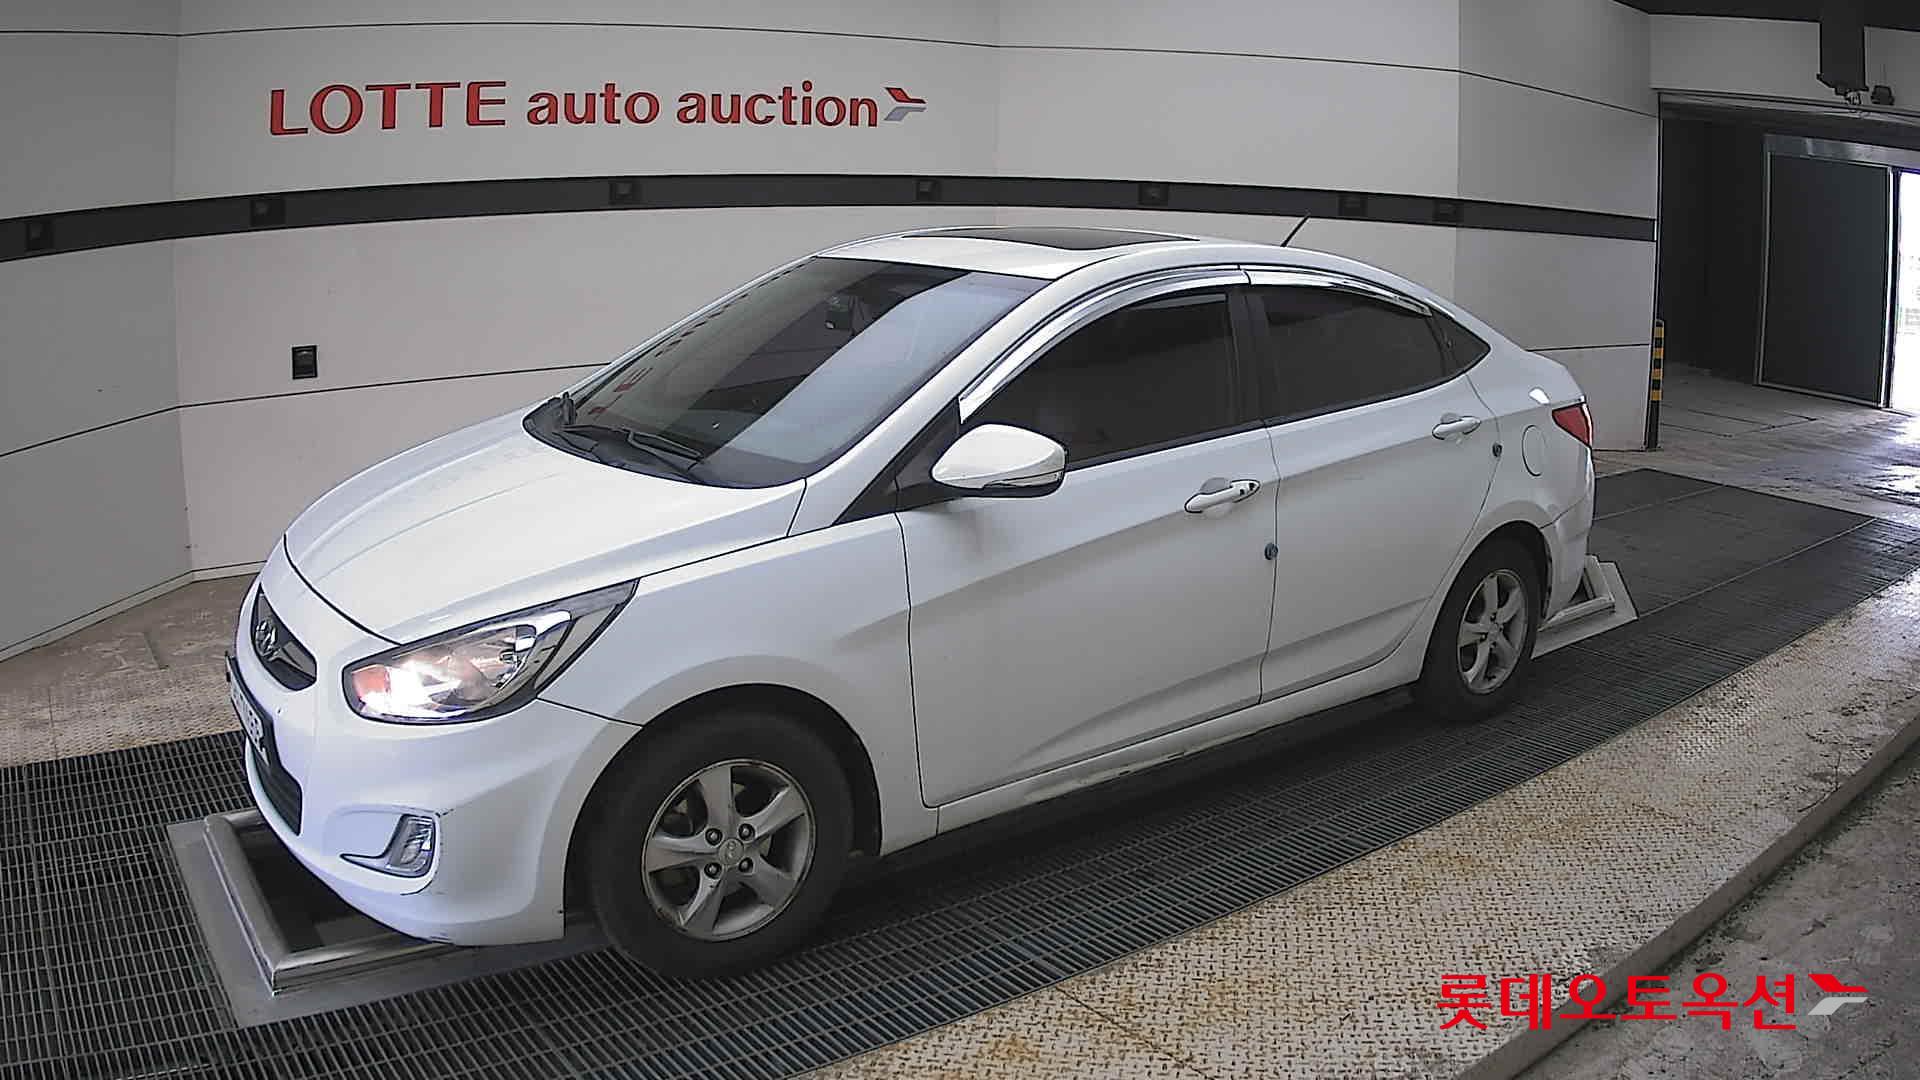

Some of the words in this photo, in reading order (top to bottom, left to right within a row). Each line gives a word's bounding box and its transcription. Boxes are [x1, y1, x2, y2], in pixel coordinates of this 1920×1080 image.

[269, 81, 506, 137] LOTTE
[526, 83, 661, 126] auto
[676, 80, 879, 128] auction
